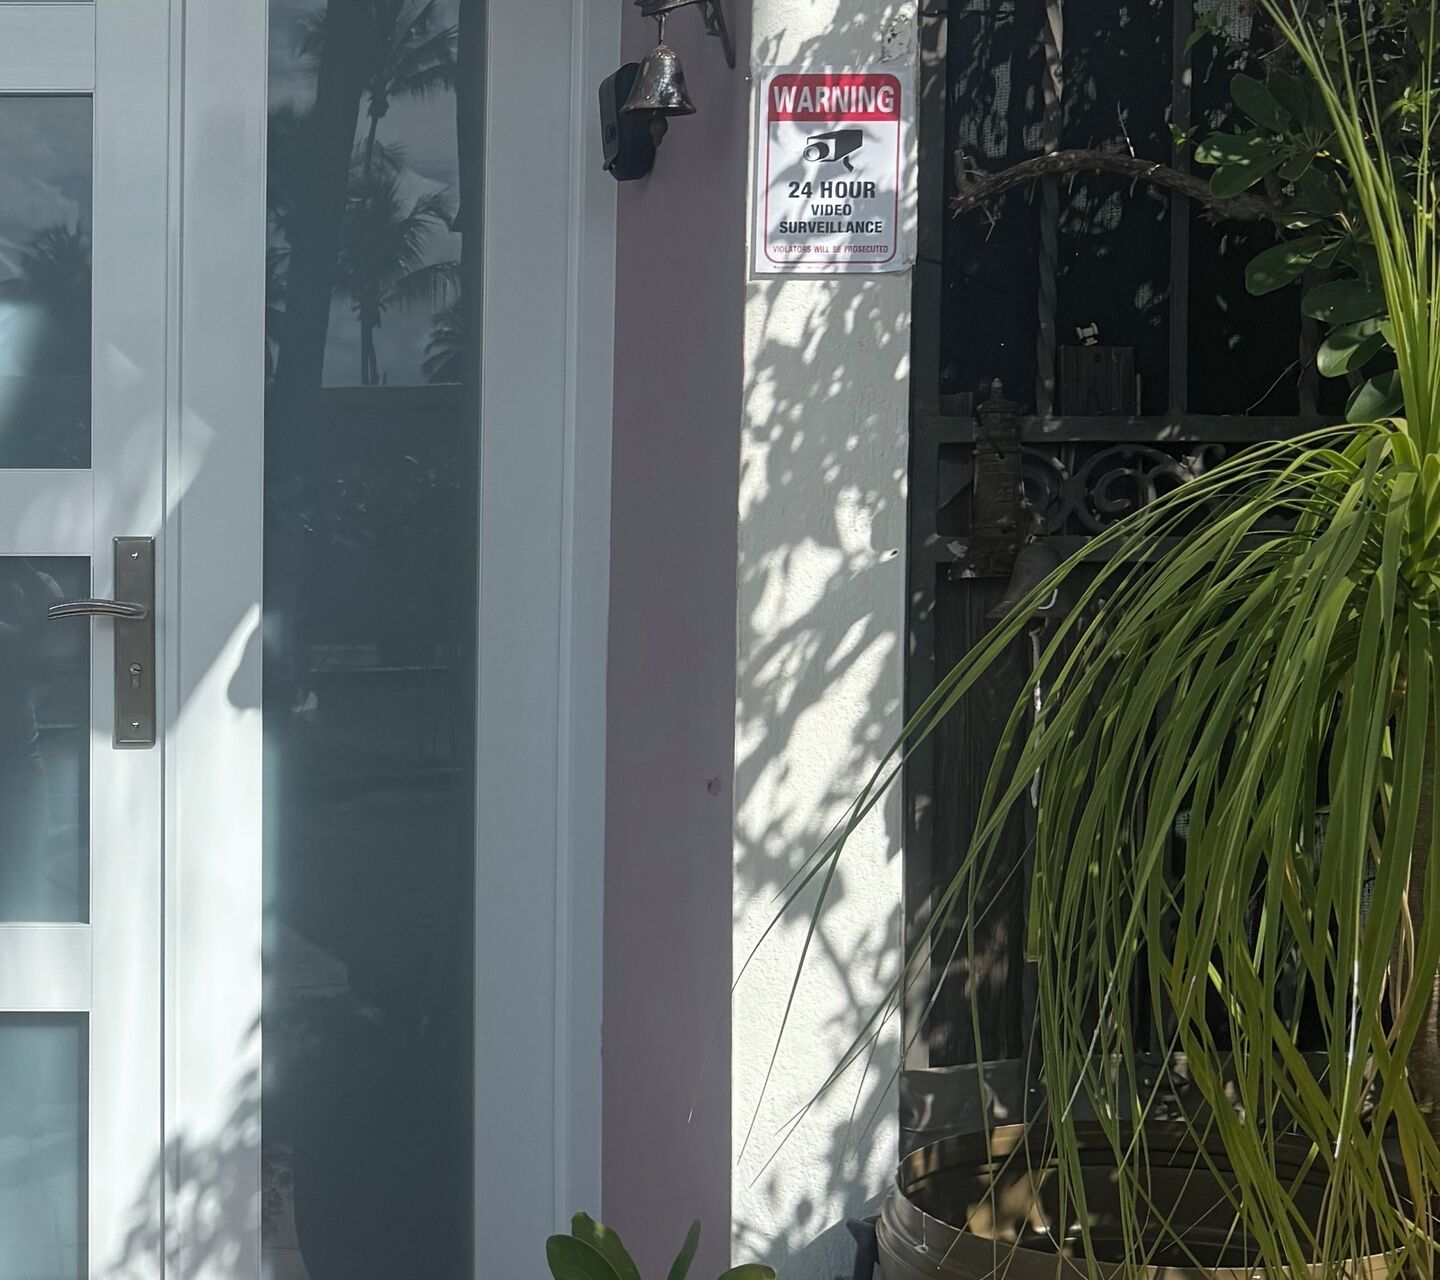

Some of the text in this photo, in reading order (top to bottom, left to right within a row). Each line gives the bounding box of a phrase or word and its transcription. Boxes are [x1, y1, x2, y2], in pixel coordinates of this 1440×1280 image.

[773, 85, 894, 114] WARNING
[788, 181, 876, 199] 24 HOUR
[811, 204, 852, 216] VIDEO
[779, 220, 882, 234] SURVEILLANCE
[772, 244, 811, 254] VIOLATORS
[814, 244, 830, 254] WILL
[844, 244, 888, 254] PROSECUTED
